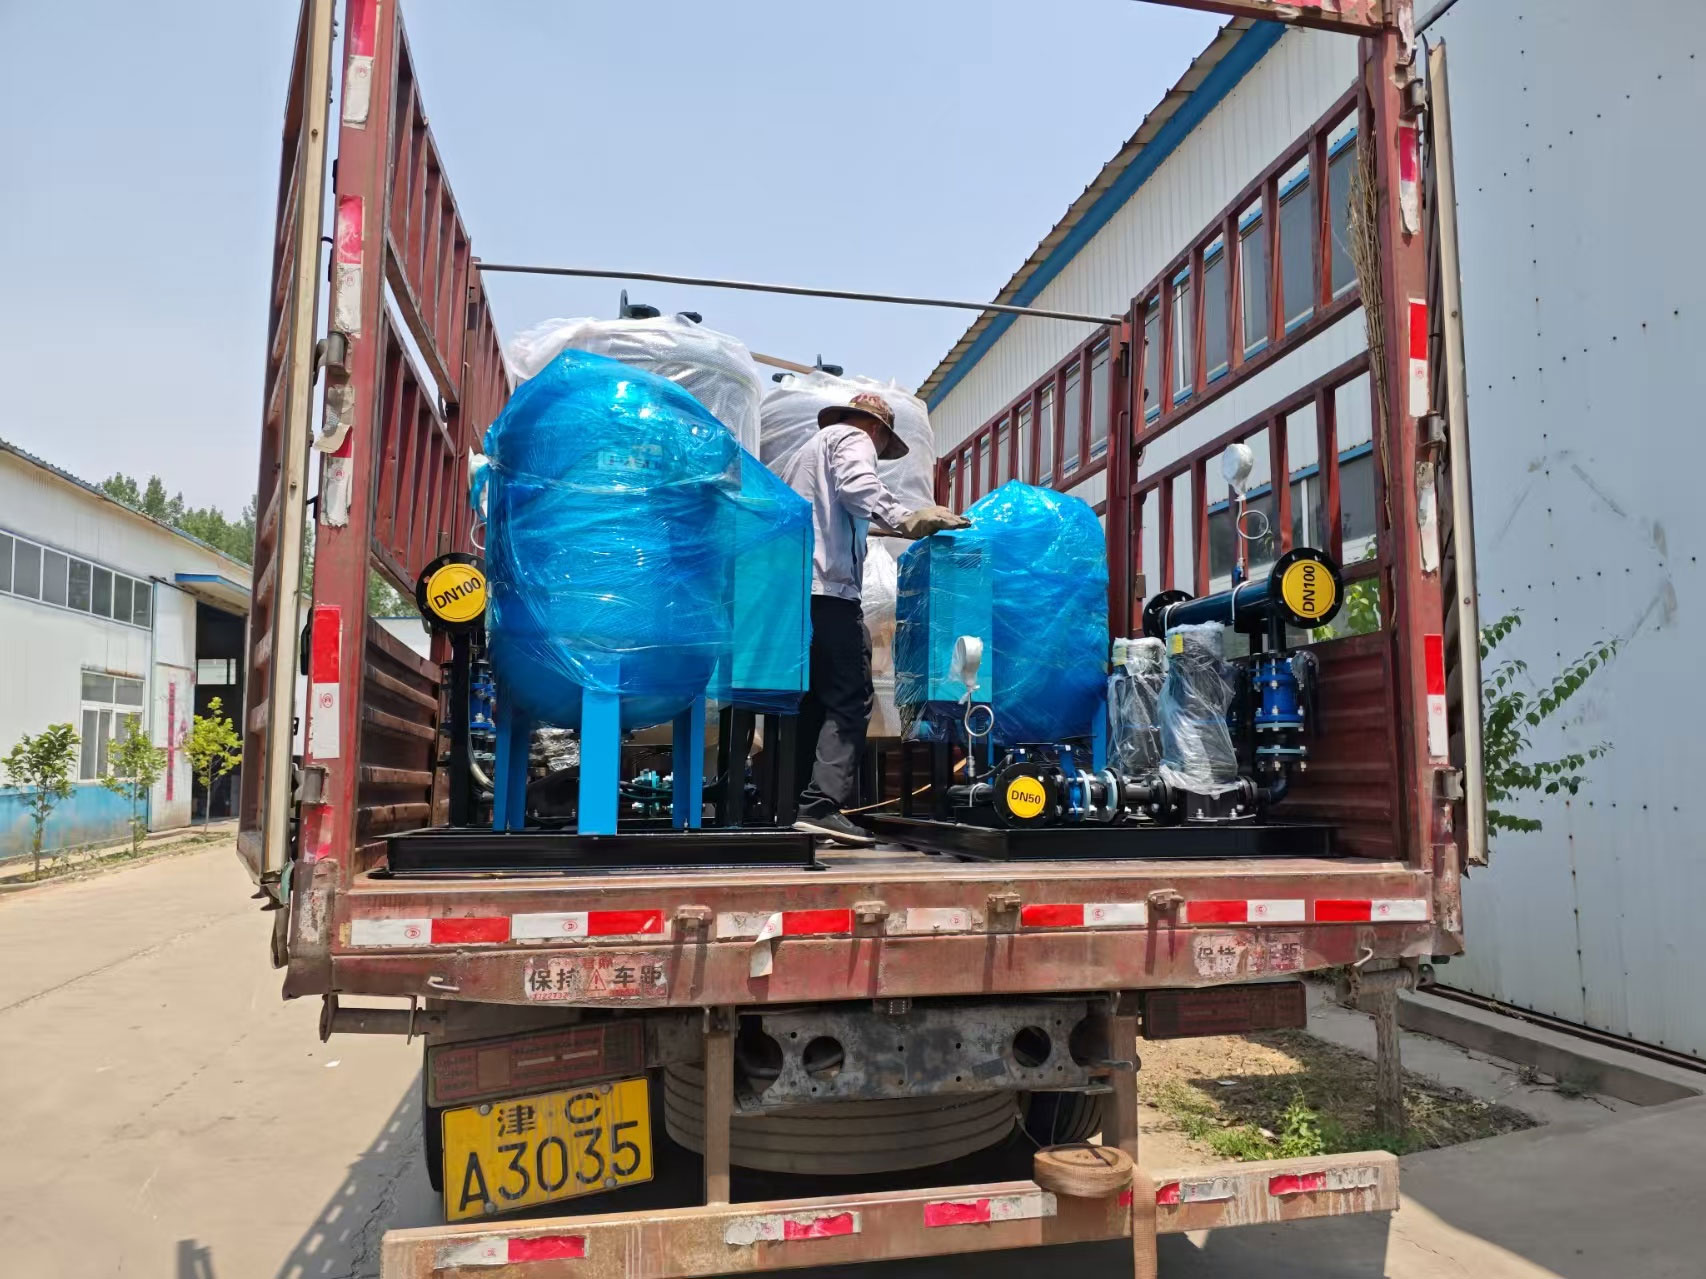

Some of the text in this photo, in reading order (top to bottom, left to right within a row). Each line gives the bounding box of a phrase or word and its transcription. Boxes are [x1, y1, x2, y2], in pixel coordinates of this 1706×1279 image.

[433, 577, 481, 609] DN100
[1302, 565, 1316, 612] DN100
[1011, 789, 1041, 805] DN50
[458, 1120, 642, 1212] A3035
